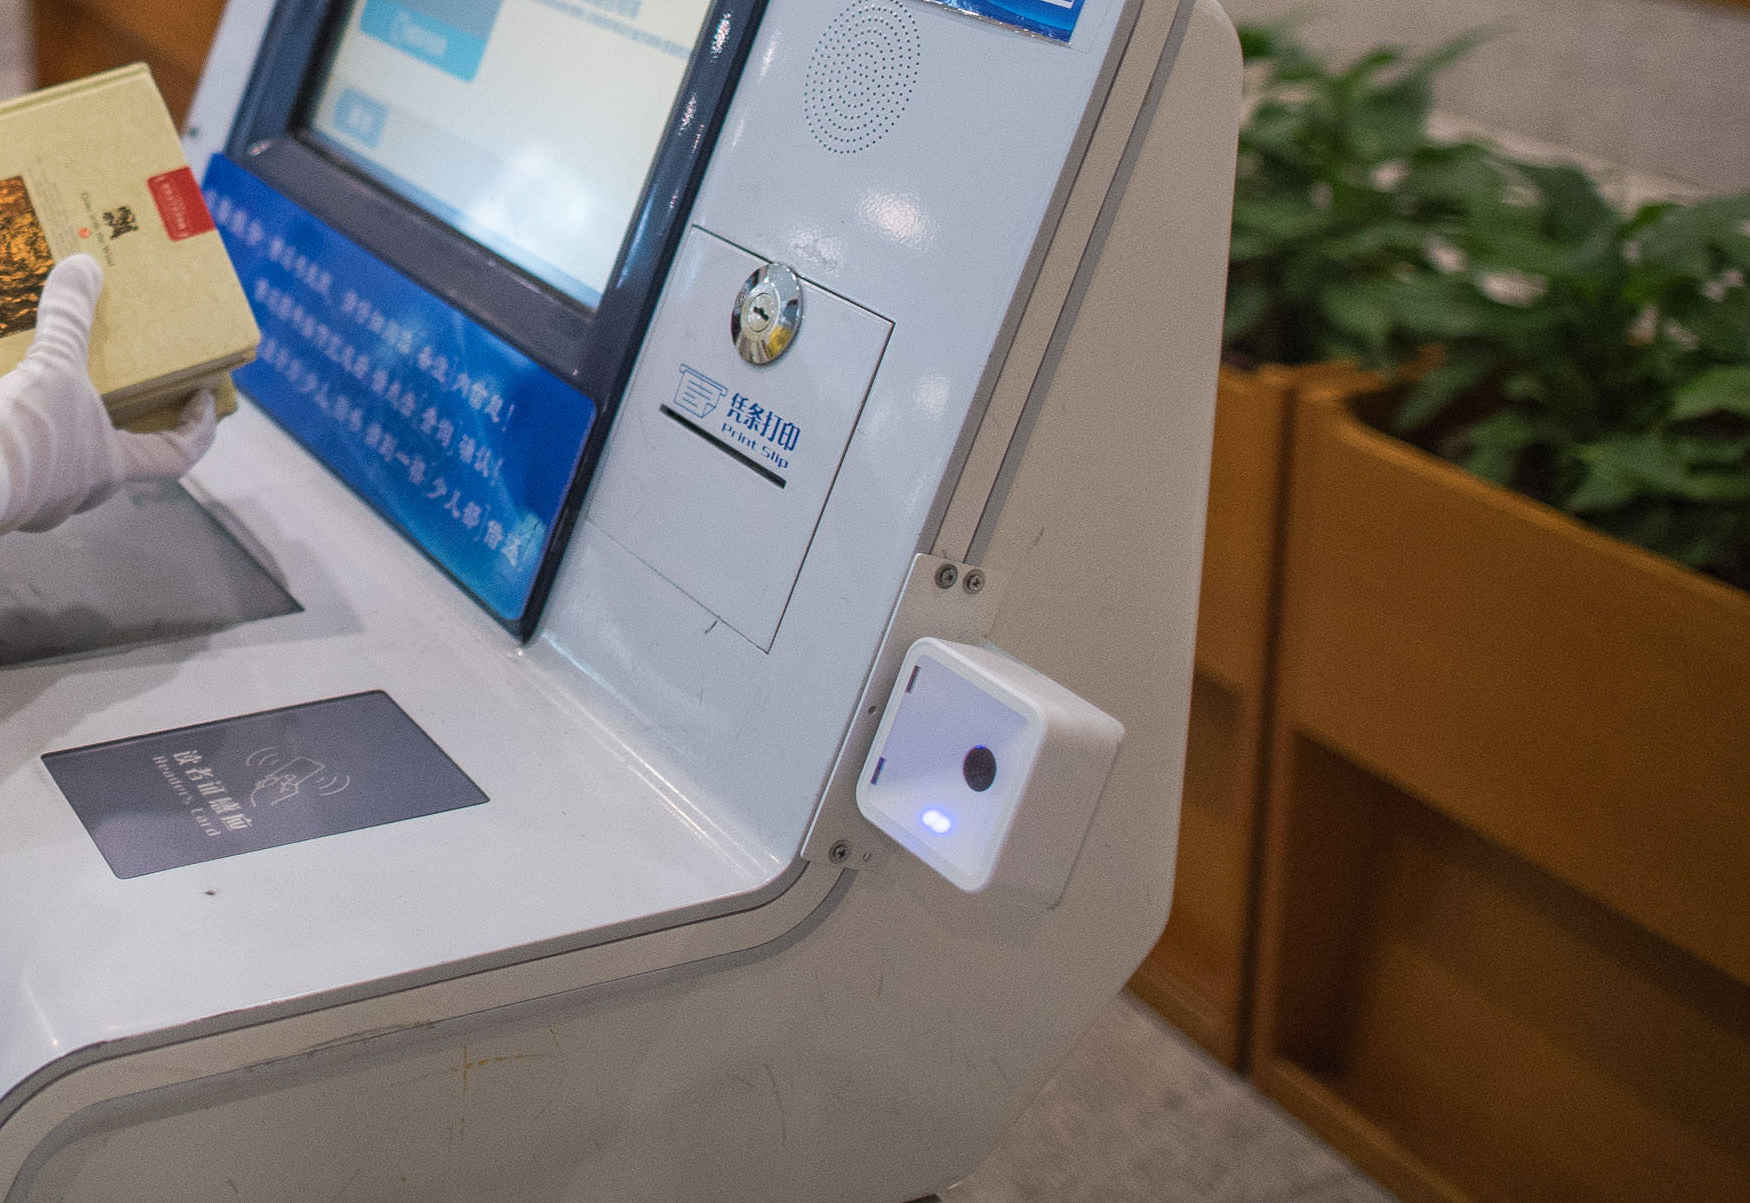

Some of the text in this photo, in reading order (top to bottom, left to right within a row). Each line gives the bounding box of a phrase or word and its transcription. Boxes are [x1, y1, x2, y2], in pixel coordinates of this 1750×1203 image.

[721, 422, 789, 469] Print Slip
[726, 392, 801, 451] 凭条打印
[173, 750, 252, 831] 读者证感应
[191, 808, 222, 837] Card
